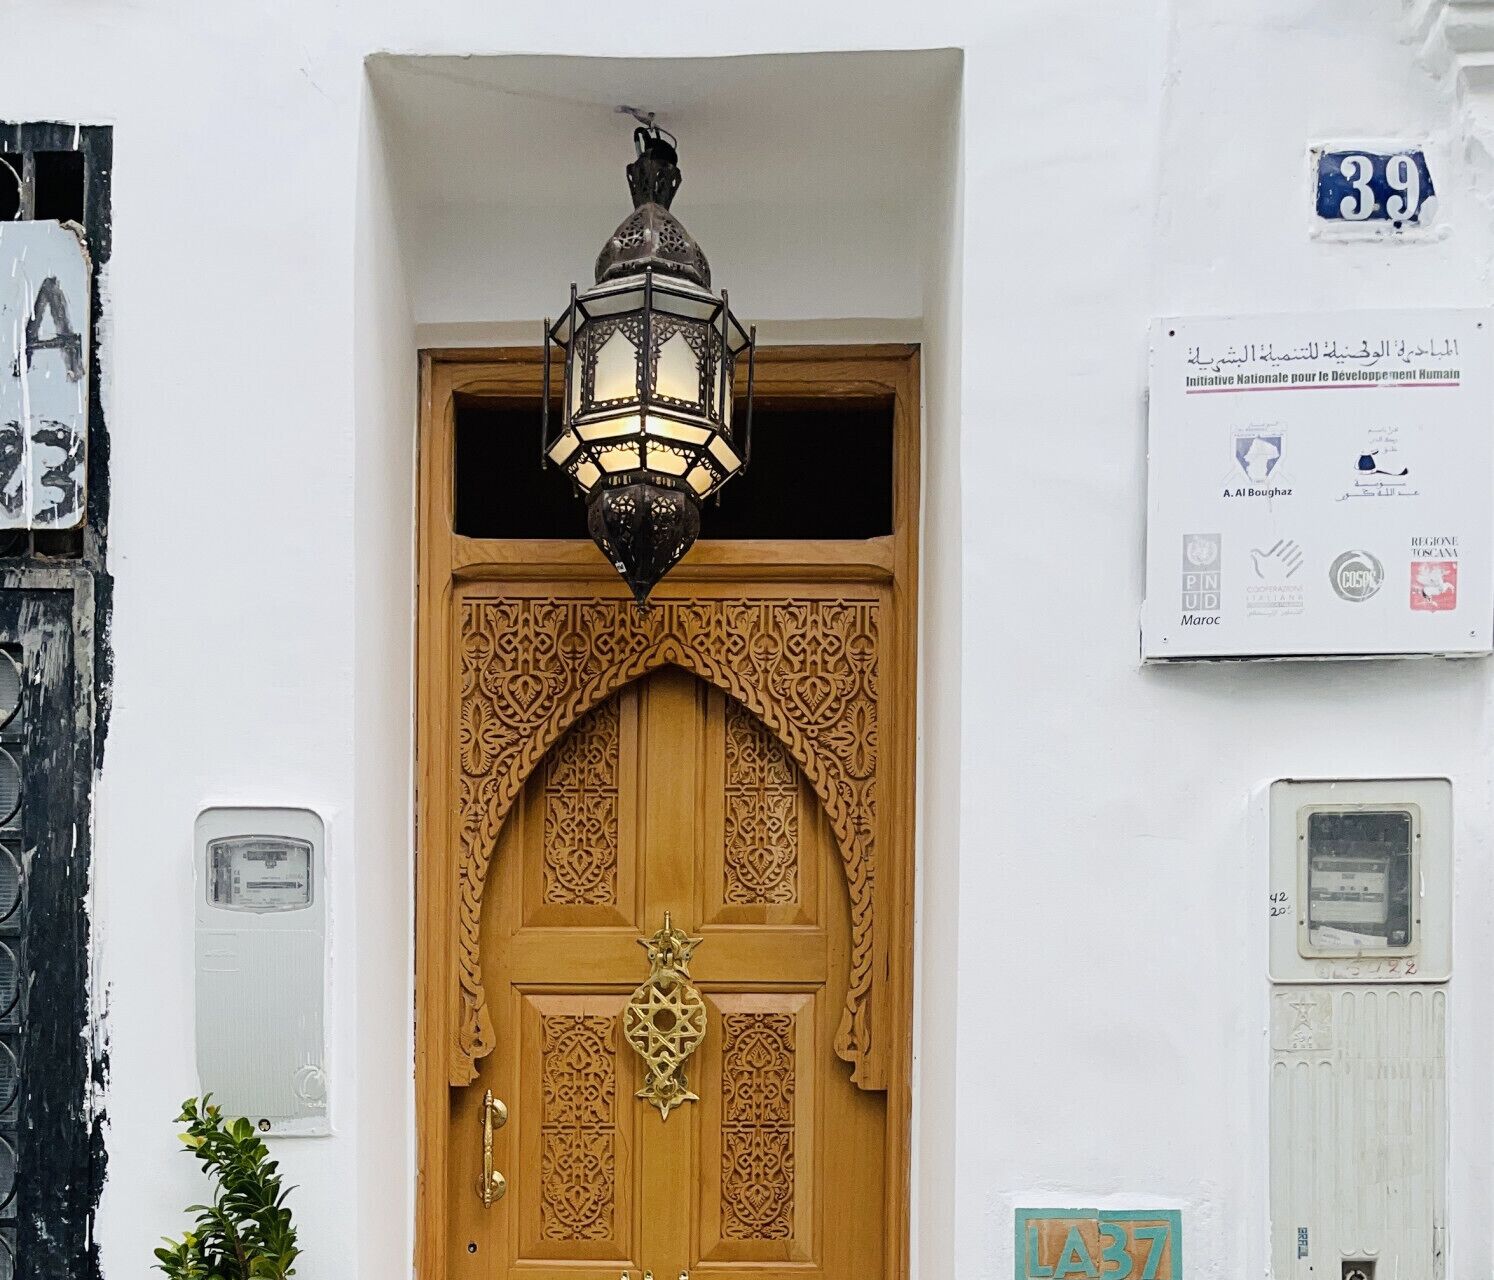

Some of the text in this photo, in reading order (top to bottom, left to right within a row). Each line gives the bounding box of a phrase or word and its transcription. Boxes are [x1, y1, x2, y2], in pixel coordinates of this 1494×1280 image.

[1340, 155, 1420, 221] 39
[12, 276, 86, 382] A
[1187, 344, 1255, 372] البشرية
[1259, 341, 1319, 367] للتنمية
[1322, 339, 1390, 367] الوطنية
[1186, 376, 1234, 387] Initiative
[1236, 372, 1289, 385] Nationale
[1290, 372, 1317, 384] pour
[1319, 370, 1329, 381] le
[1419, 367, 1460, 380] Humain
[1235, 488, 1246, 497] Al
[1248, 486, 1293, 499] Boughaz
[1410, 536, 1457, 547] REGIONE
[1411, 548, 1458, 558] TOSCANA
[1180, 614, 1221, 626] Maroc
[1269, 891, 1289, 904] 42
